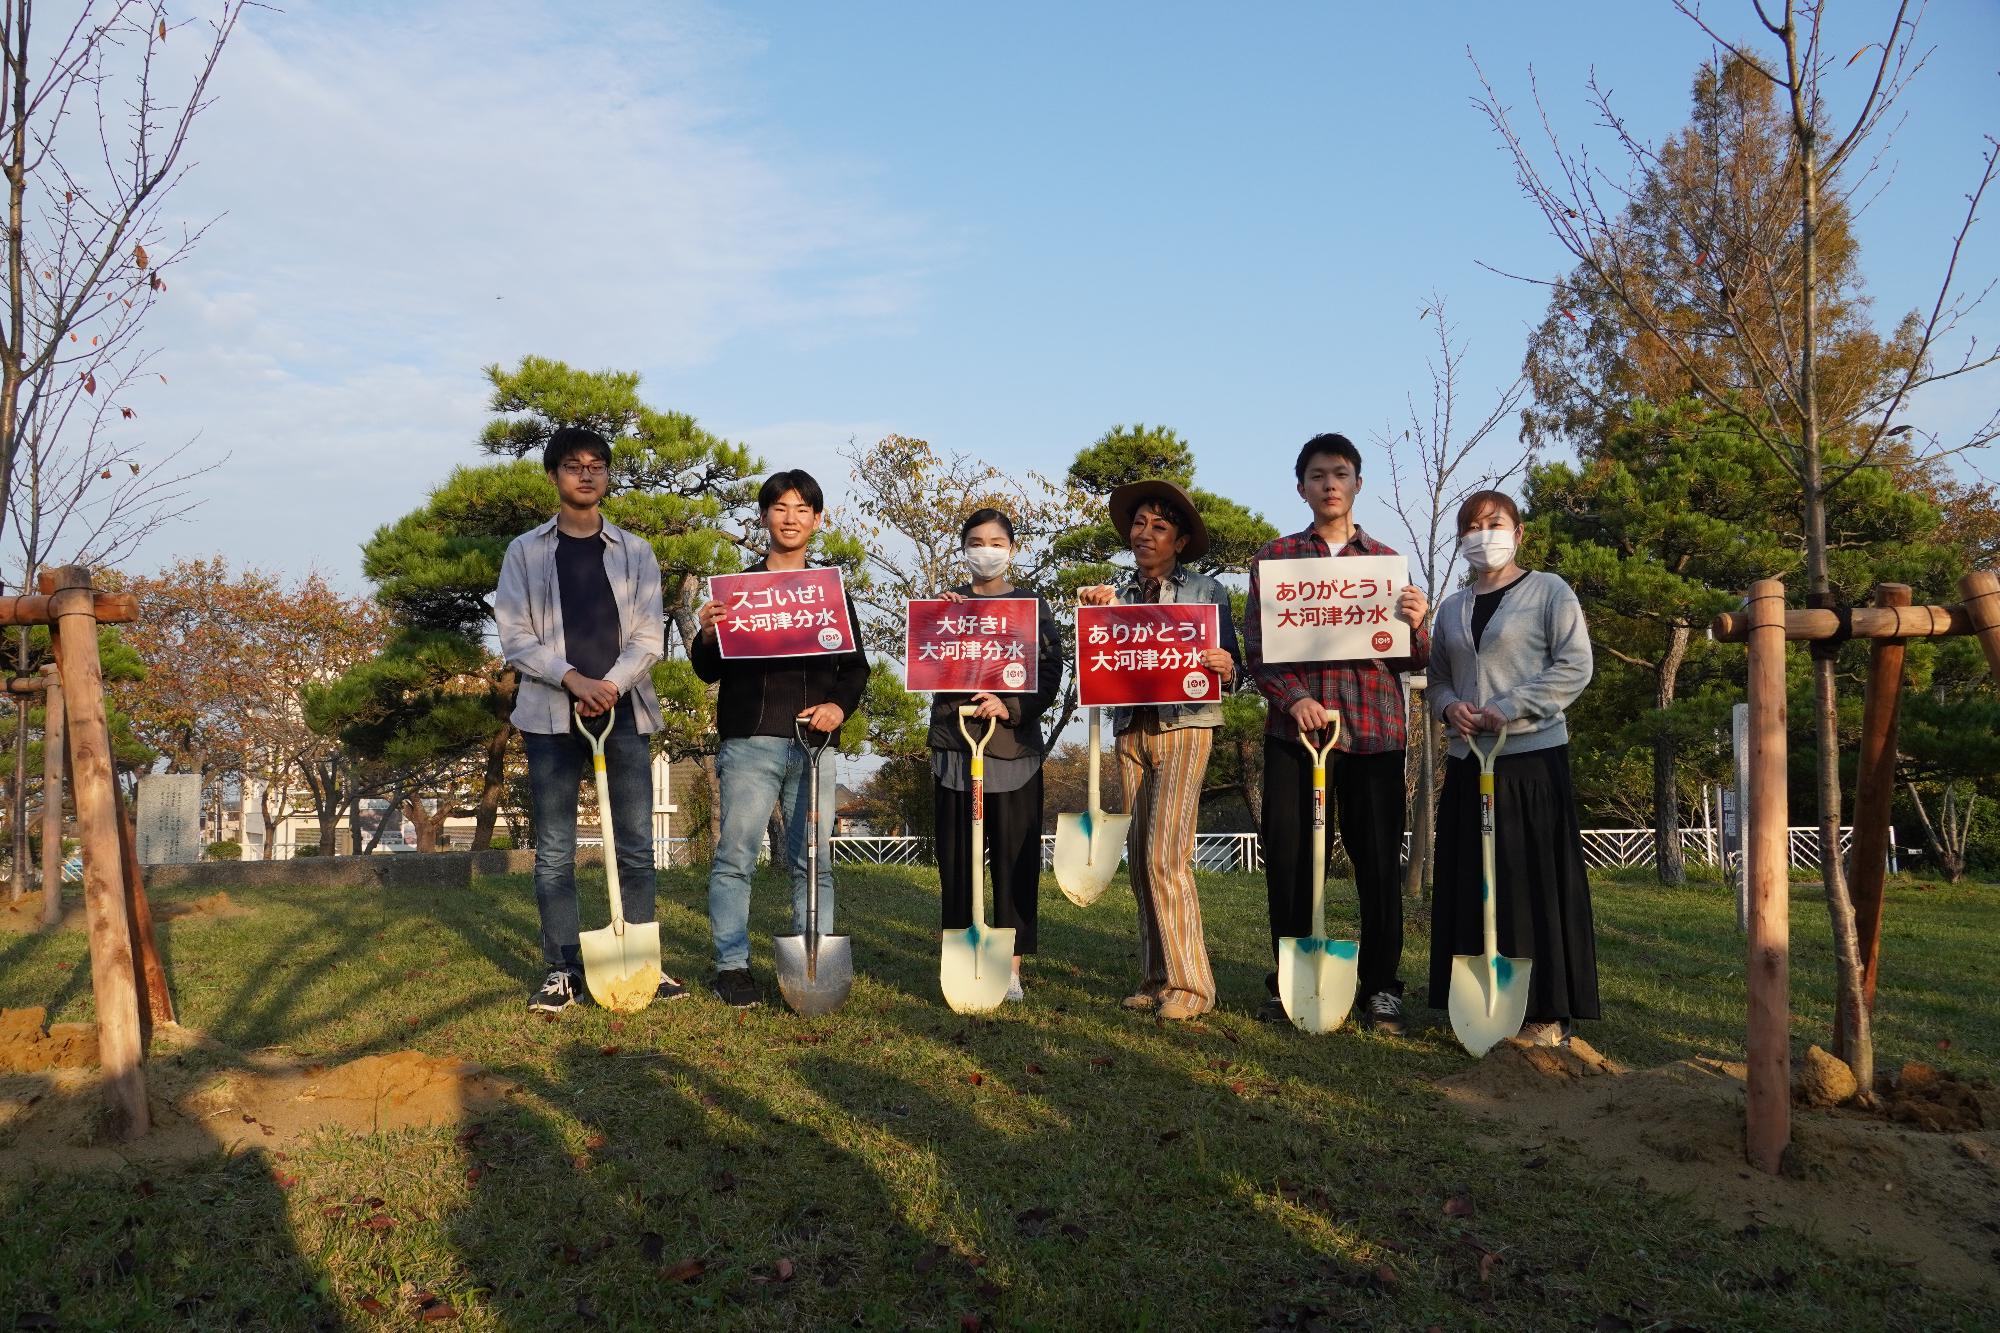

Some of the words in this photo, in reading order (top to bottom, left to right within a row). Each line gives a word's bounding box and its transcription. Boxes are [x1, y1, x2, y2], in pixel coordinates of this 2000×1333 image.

[732, 585, 825, 611] スゴいぜ!
[1275, 579, 1393, 602] ありがとう！
[727, 608, 838, 633] 大河津分水
[935, 615, 1008, 636] 大好き!
[1277, 604, 1389, 628] 大河津分水
[1088, 621, 1206, 645] ありがとう!
[918, 640, 1026, 661] 大河津分水
[1090, 647, 1206, 672] 大河津分水
